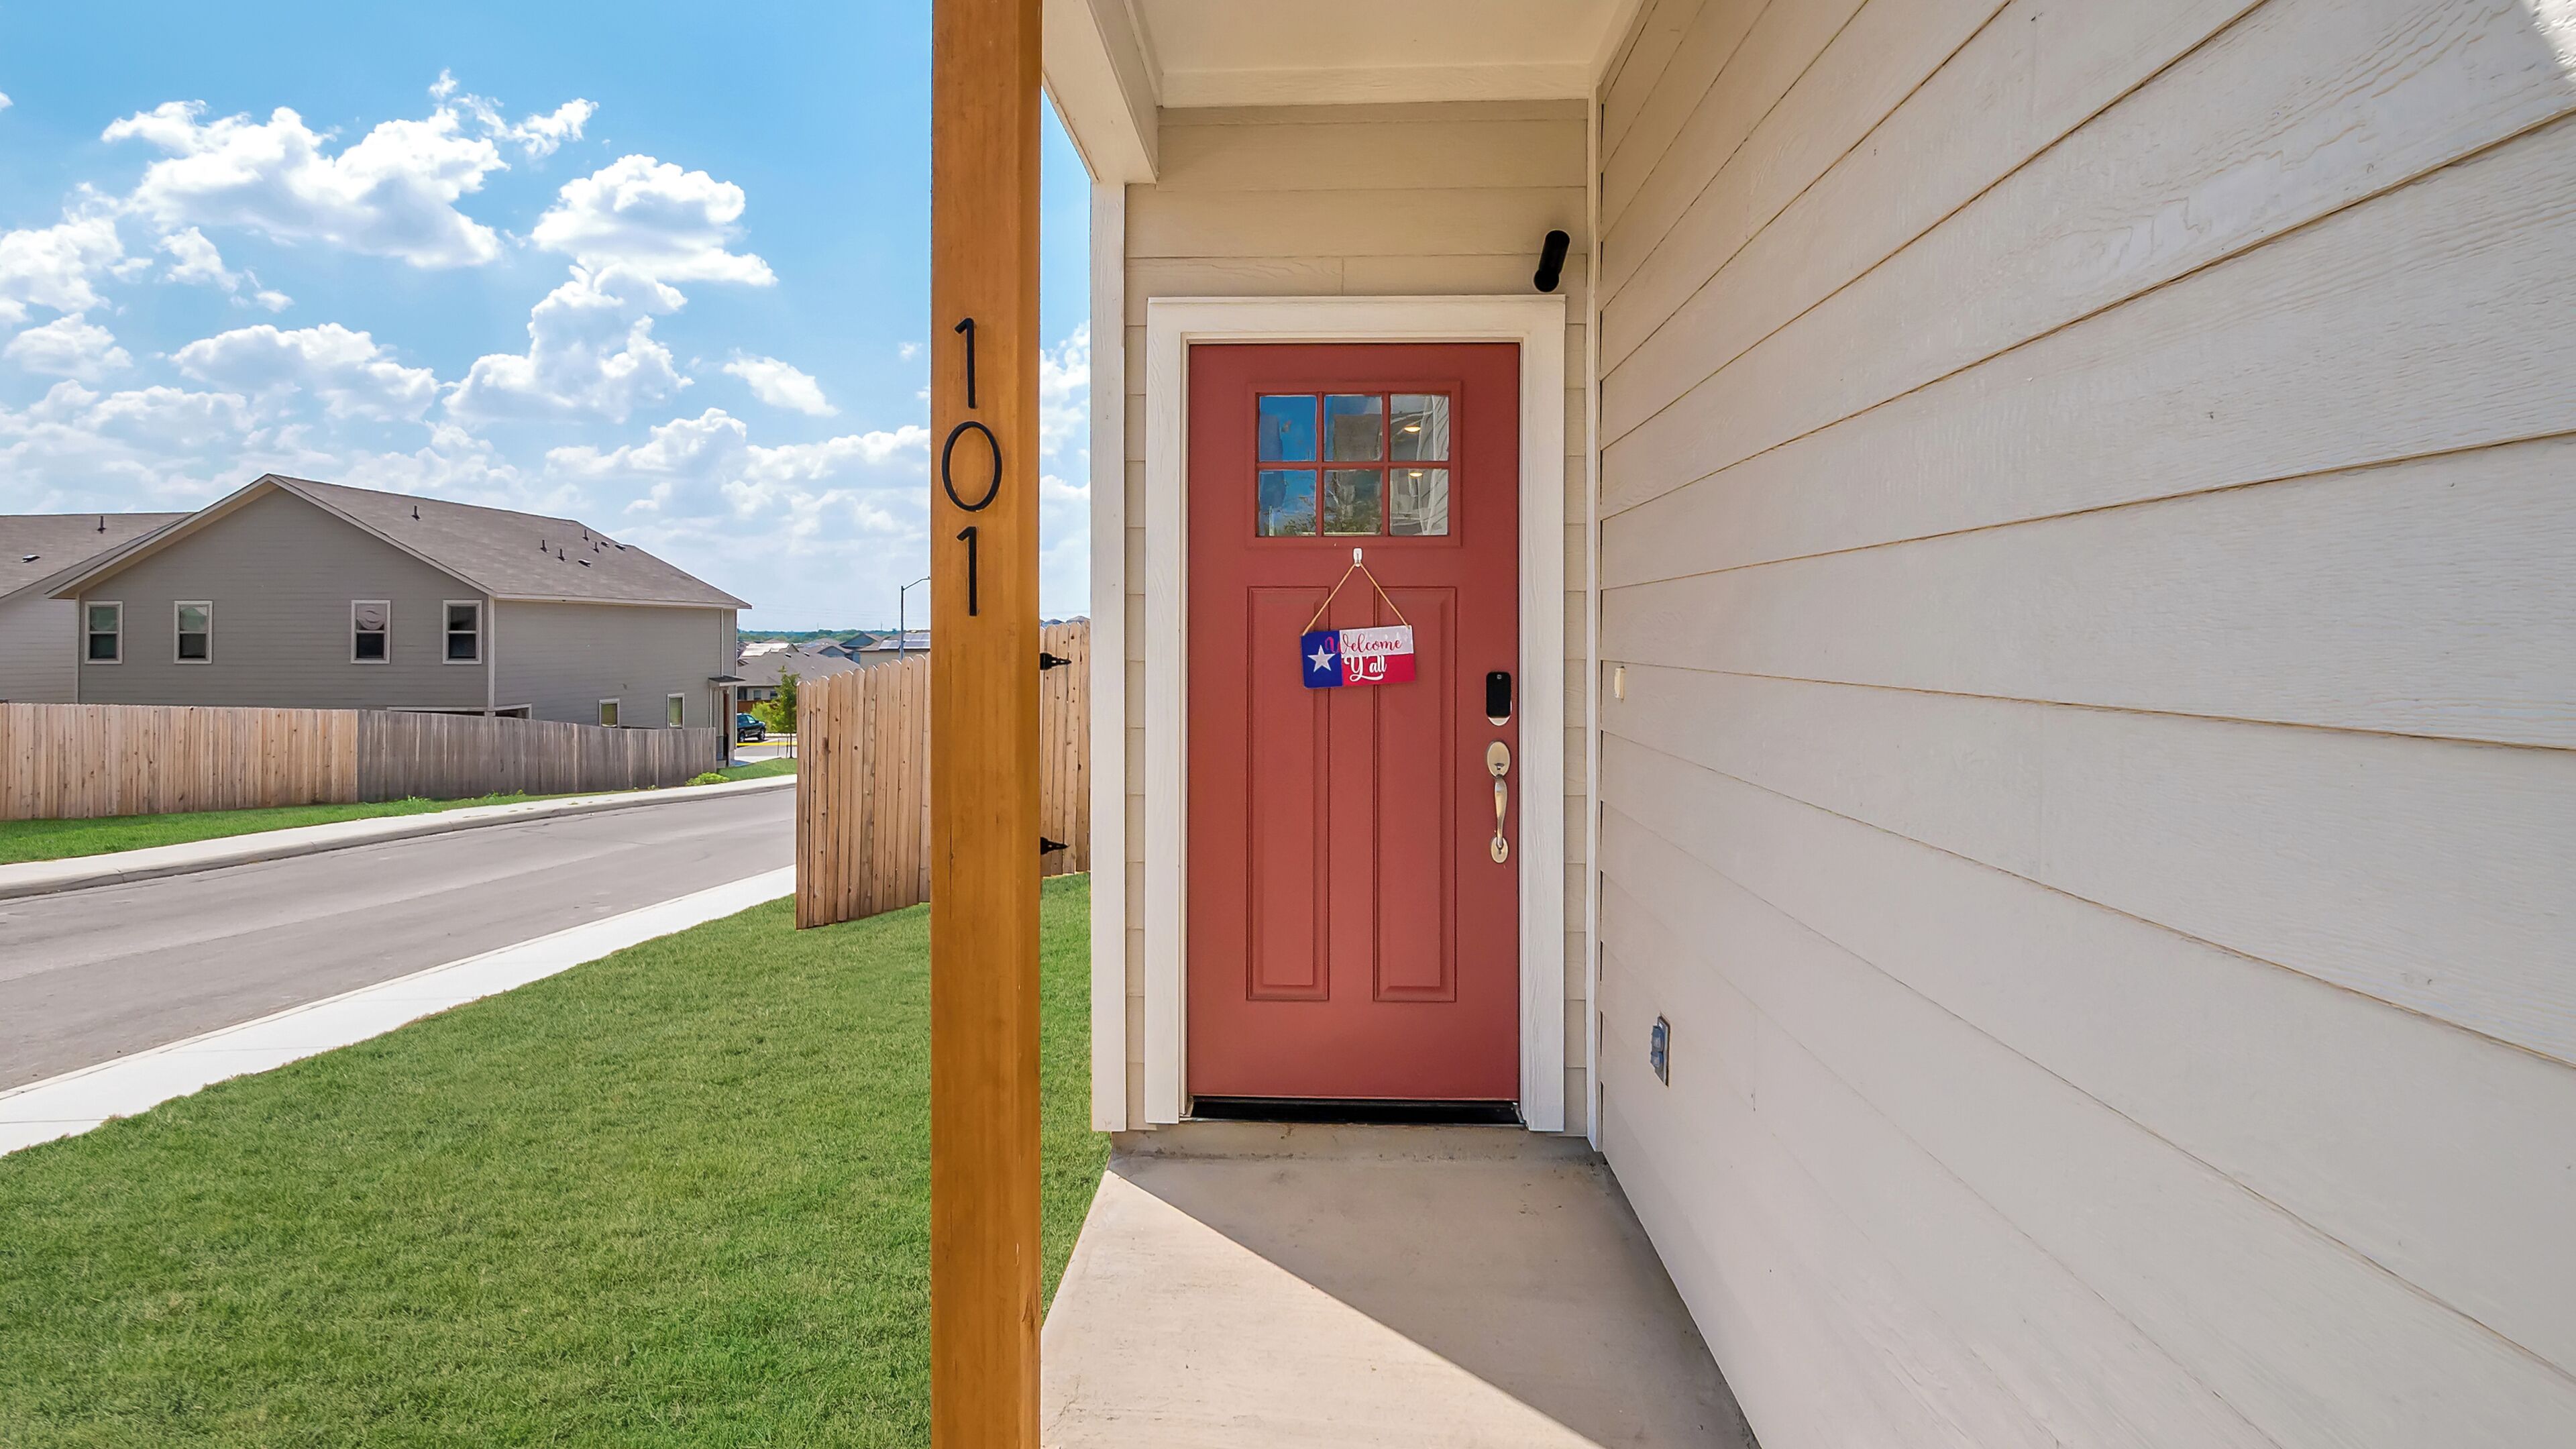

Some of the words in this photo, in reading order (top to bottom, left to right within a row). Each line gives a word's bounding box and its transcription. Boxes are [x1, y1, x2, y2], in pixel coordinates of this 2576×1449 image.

[941, 317, 1002, 616] 101
[1324, 633, 1402, 655] Welcome
[1344, 655, 1387, 682] Y'all
